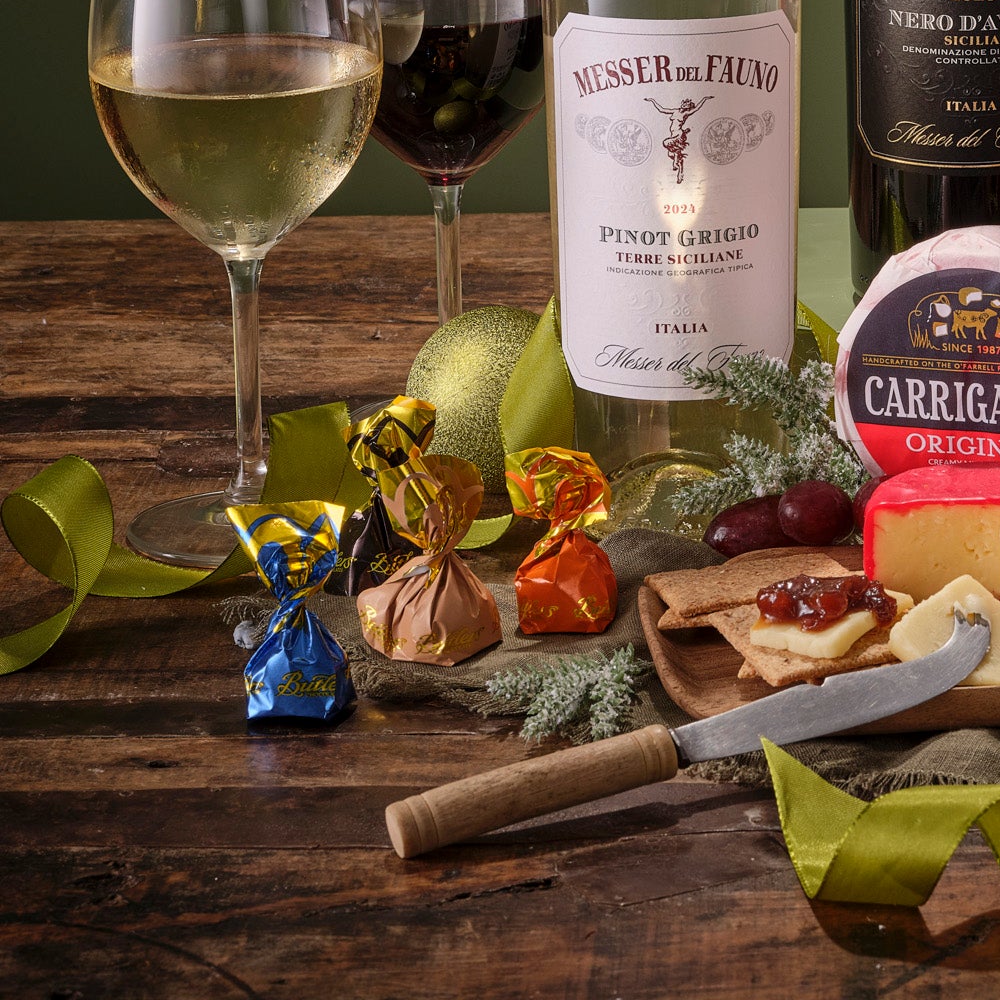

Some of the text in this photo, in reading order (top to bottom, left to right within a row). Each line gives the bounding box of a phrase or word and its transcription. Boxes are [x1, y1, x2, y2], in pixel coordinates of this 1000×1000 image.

[888, 8, 954, 31] NERO
[944, 34, 1000, 47] SICILIA
[902, 45, 987, 56] DENOMINAZIONE
[990, 47, 1000, 55] DI
[573, 54, 779, 98] MESSER DEL FAUNO
[946, 100, 997, 112] ITALIA
[886, 120, 954, 148] Messer
[956, 128, 990, 148] del
[663, 203, 696, 215] 2024
[599, 223, 759, 247] PINOT GRIGIO
[616, 249, 744, 265] TERRE SICILIANE
[606, 263, 754, 277] INDICAZIONE GEOGRAFICA TIPICA
[655, 323, 709, 334] ITALIA
[942, 342, 973, 354] SINCE
[595, 344, 663, 371] Messer
[665, 351, 701, 371] del
[862, 356, 920, 367] HANDCRAFTED
[921, 360, 935, 368] ON
[936, 361, 952, 369] THE
[953, 361, 995, 372] O'FARRELL
